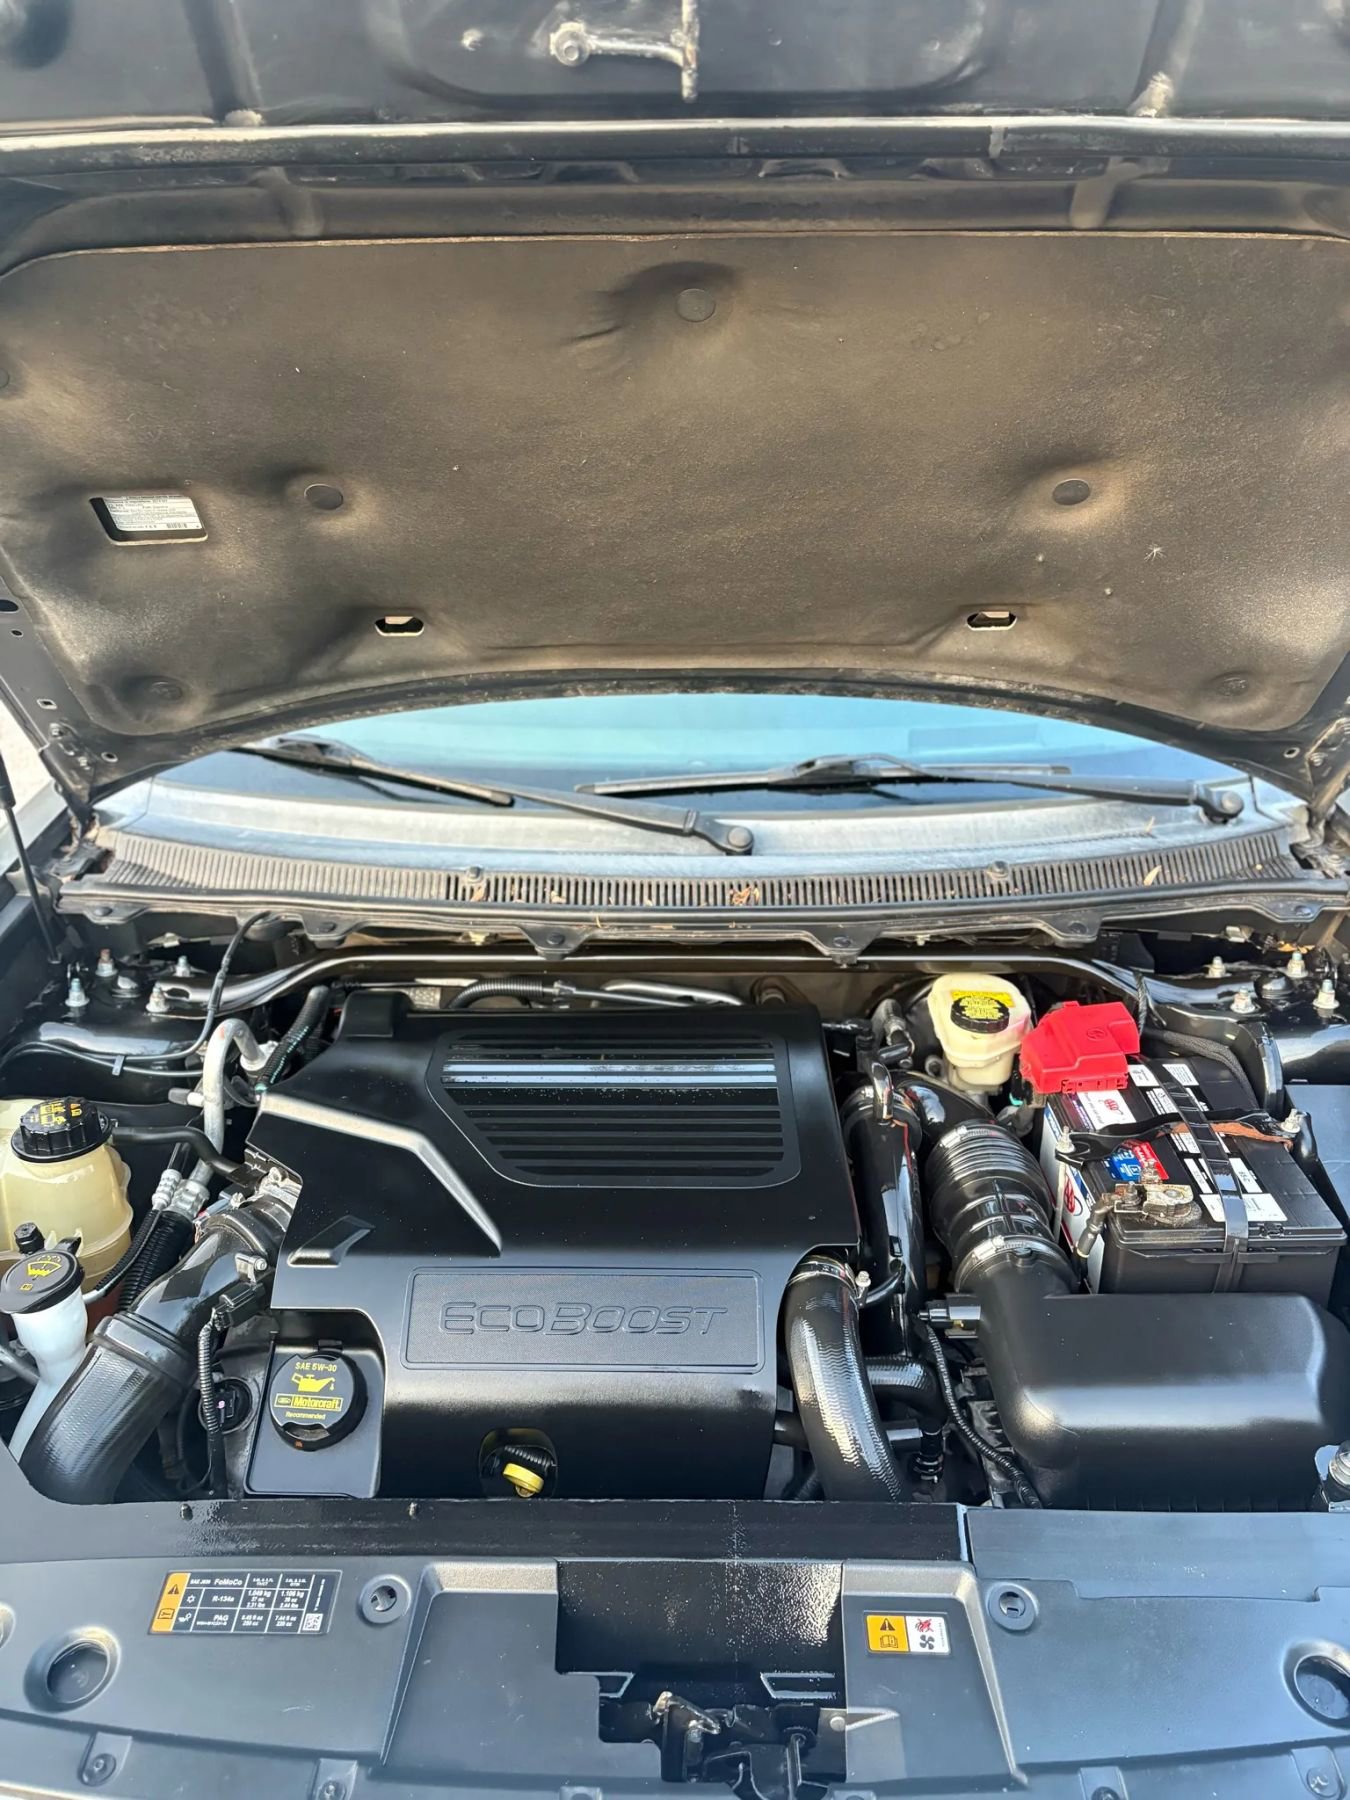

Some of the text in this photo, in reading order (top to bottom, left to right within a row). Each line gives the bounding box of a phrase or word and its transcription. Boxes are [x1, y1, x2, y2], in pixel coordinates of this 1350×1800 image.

[295, 1362, 337, 1372] SAE 5W-30
[293, 1395, 340, 1410] Motorcraft
[285, 1411, 326, 1420] Recommended
[214, 1578, 243, 1586] FoMoCo
